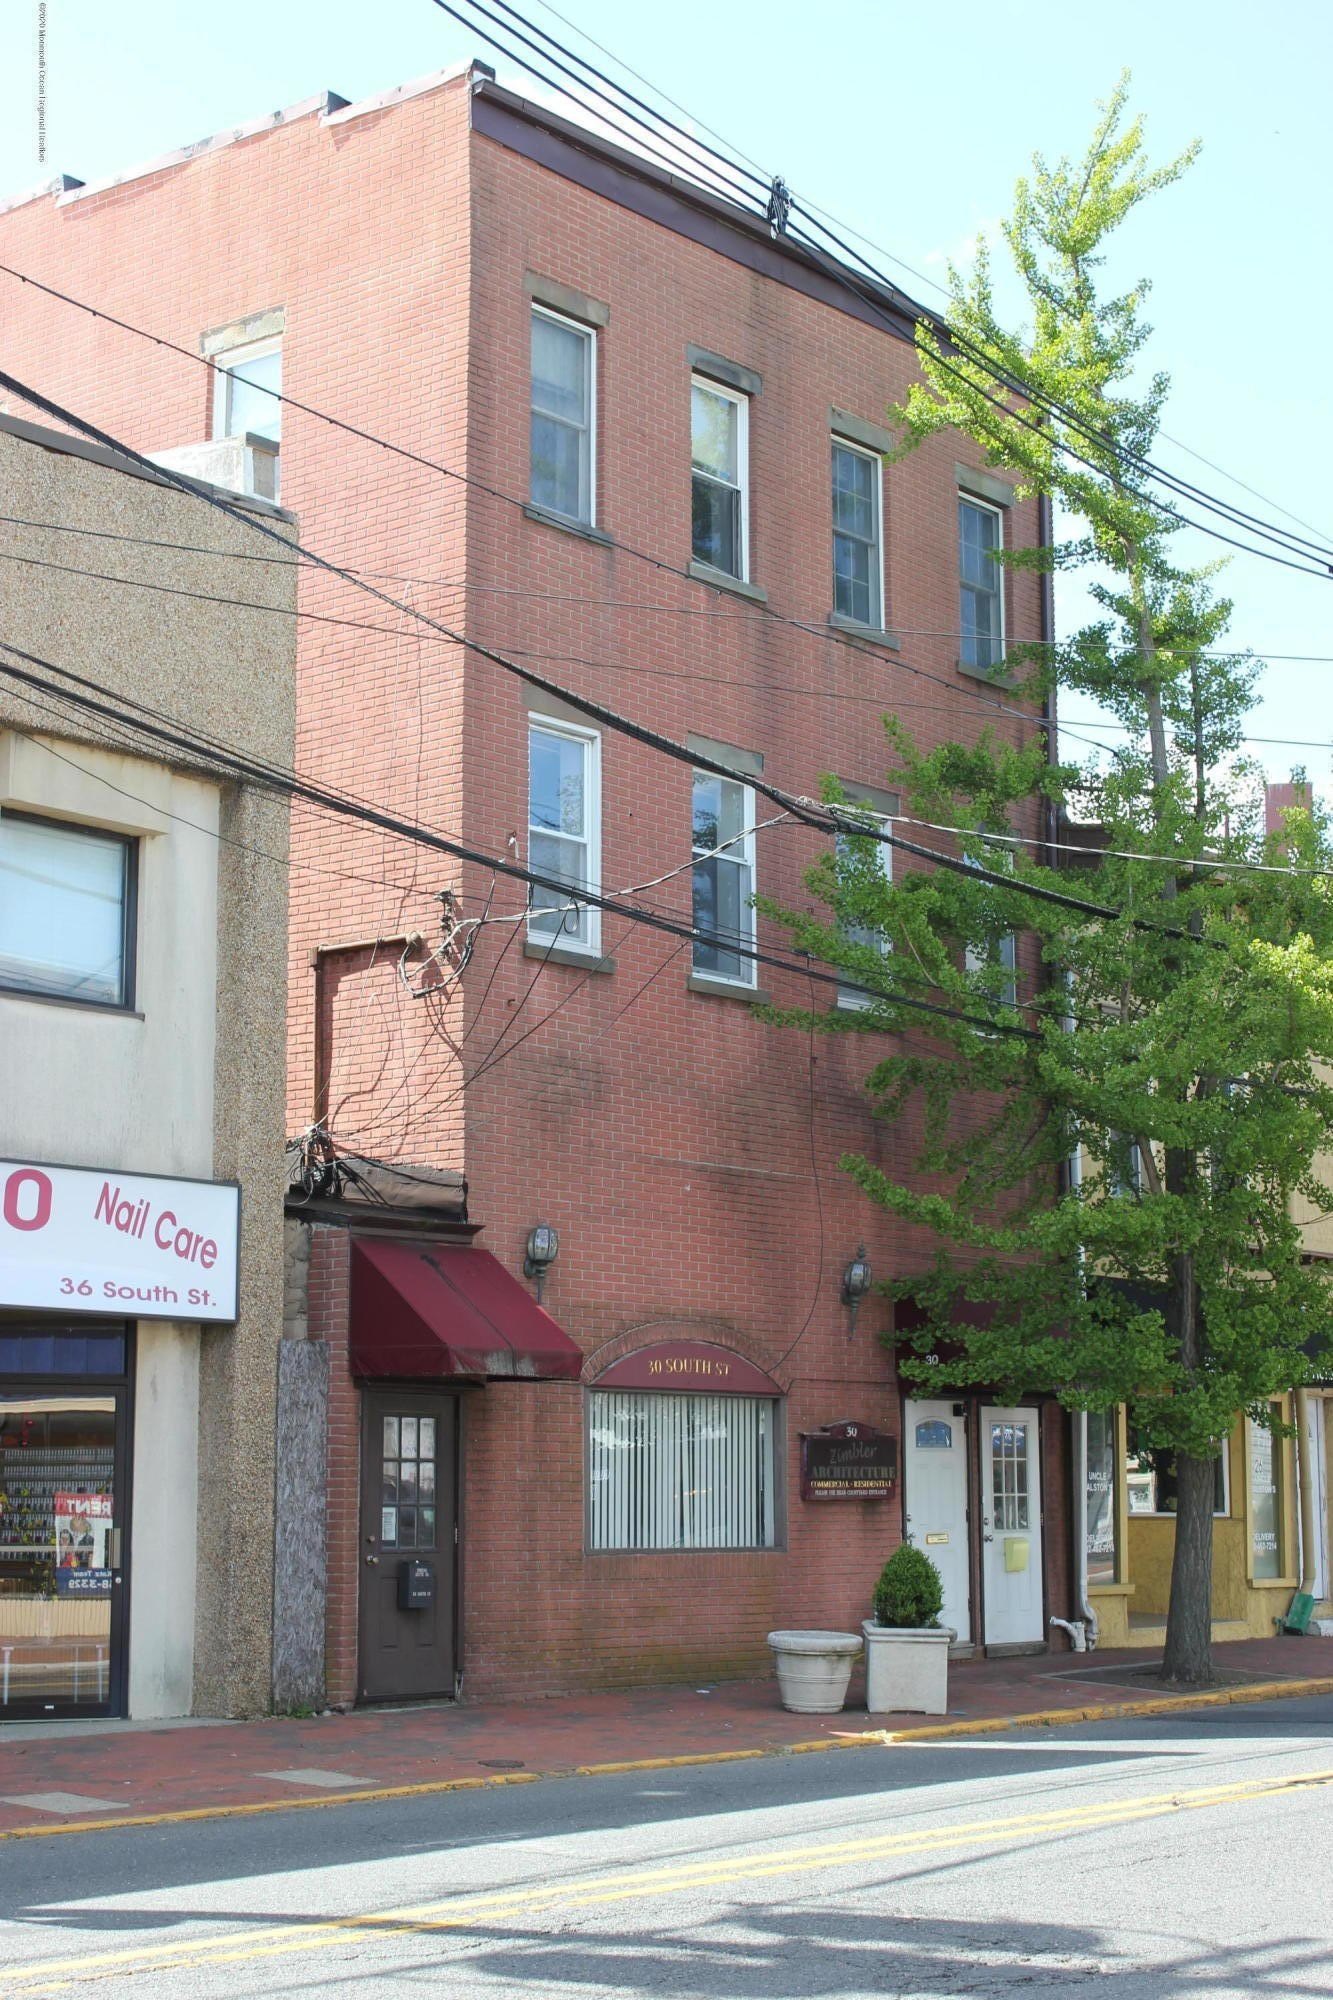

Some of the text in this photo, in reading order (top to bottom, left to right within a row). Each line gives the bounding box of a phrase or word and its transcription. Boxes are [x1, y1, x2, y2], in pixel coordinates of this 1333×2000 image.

[94, 1181, 218, 1269] Nail Care
[59, 1277, 217, 1307] 36 South St.
[926, 1354, 939, 1365] 30
[648, 1358, 731, 1376] 30 SOUTH ST
[846, 1427, 857, 1436] 30
[830, 1441, 878, 1464] Zimbler
[811, 1465, 896, 1479] ARCHITECTURE
[1089, 1472, 1106, 1480] UNCLE
[810, 1480, 891, 1488] COMMERCIAL RESIDENTIAL
